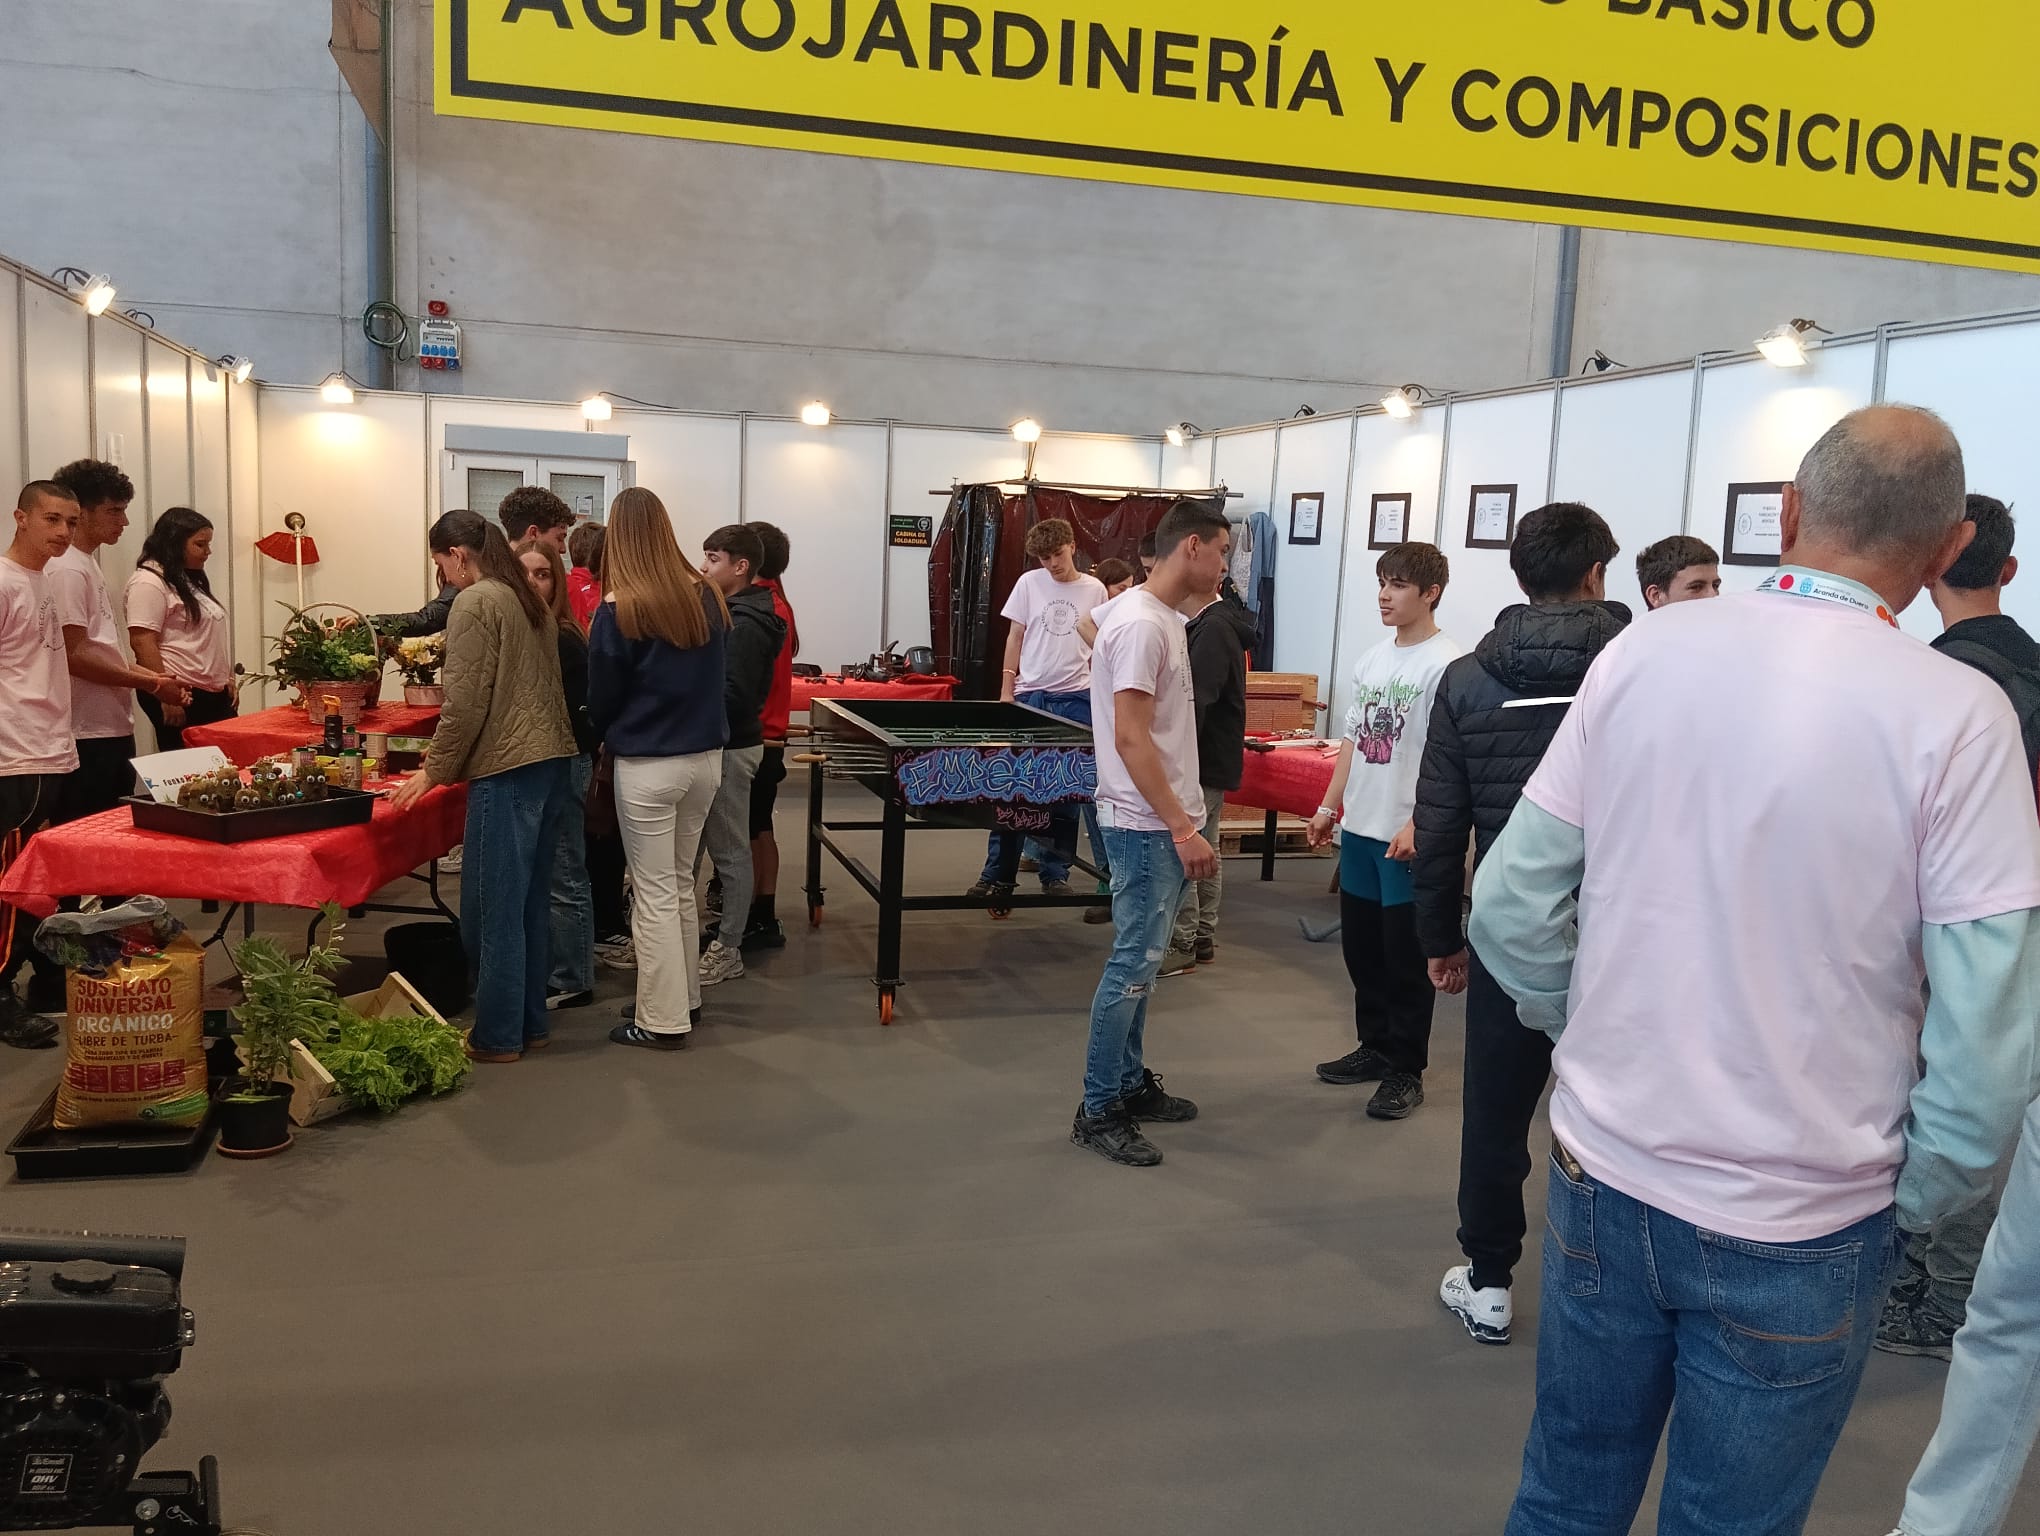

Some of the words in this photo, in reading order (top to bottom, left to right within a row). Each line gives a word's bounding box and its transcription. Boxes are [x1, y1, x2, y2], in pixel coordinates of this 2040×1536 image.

[1374, 57, 1427, 123] Y
[1450, 68, 2039, 198] COMPOSICIONES
[895, 530, 917, 538] CABINA
[1813, 588, 1839, 599] Aranda
[1839, 594, 1849, 602] de
[1849, 597, 1869, 610] Duero
[77, 977, 172, 997] SUSTRATO
[74, 994, 177, 1014] UNIVERSAL
[76, 1013, 174, 1033] ORGÁNICO
[111, 1036, 128, 1047] DE
[1490, 1305, 1505, 1313] NIKE
[31, 1475, 58, 1483] OHV
